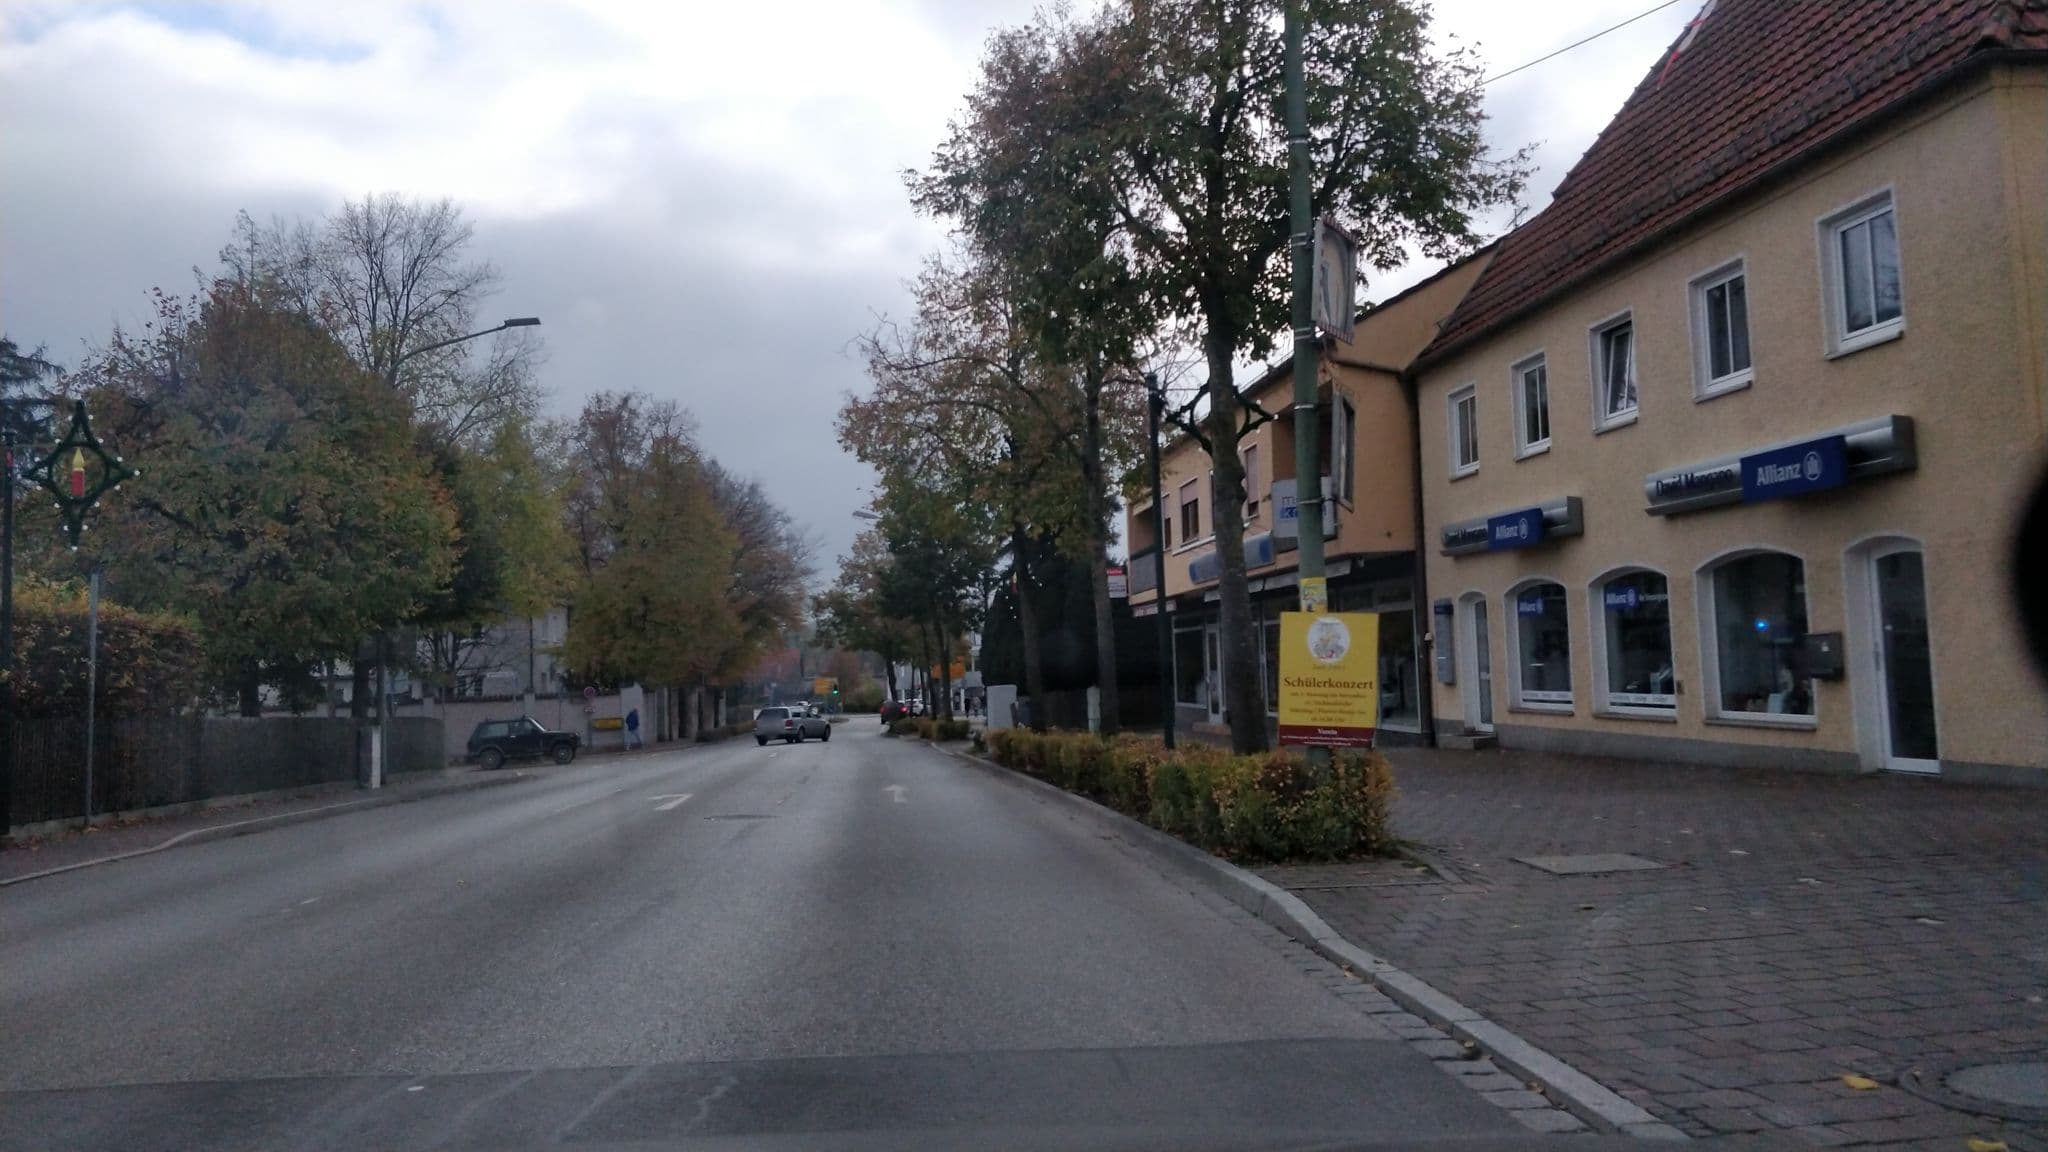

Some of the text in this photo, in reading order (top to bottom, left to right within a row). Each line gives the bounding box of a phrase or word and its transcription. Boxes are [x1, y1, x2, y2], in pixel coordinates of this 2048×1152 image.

[1757, 462, 1801, 487] Allianz
[1495, 524, 1518, 540] Allianz
[1283, 676, 1374, 690] Schülerkonzert
